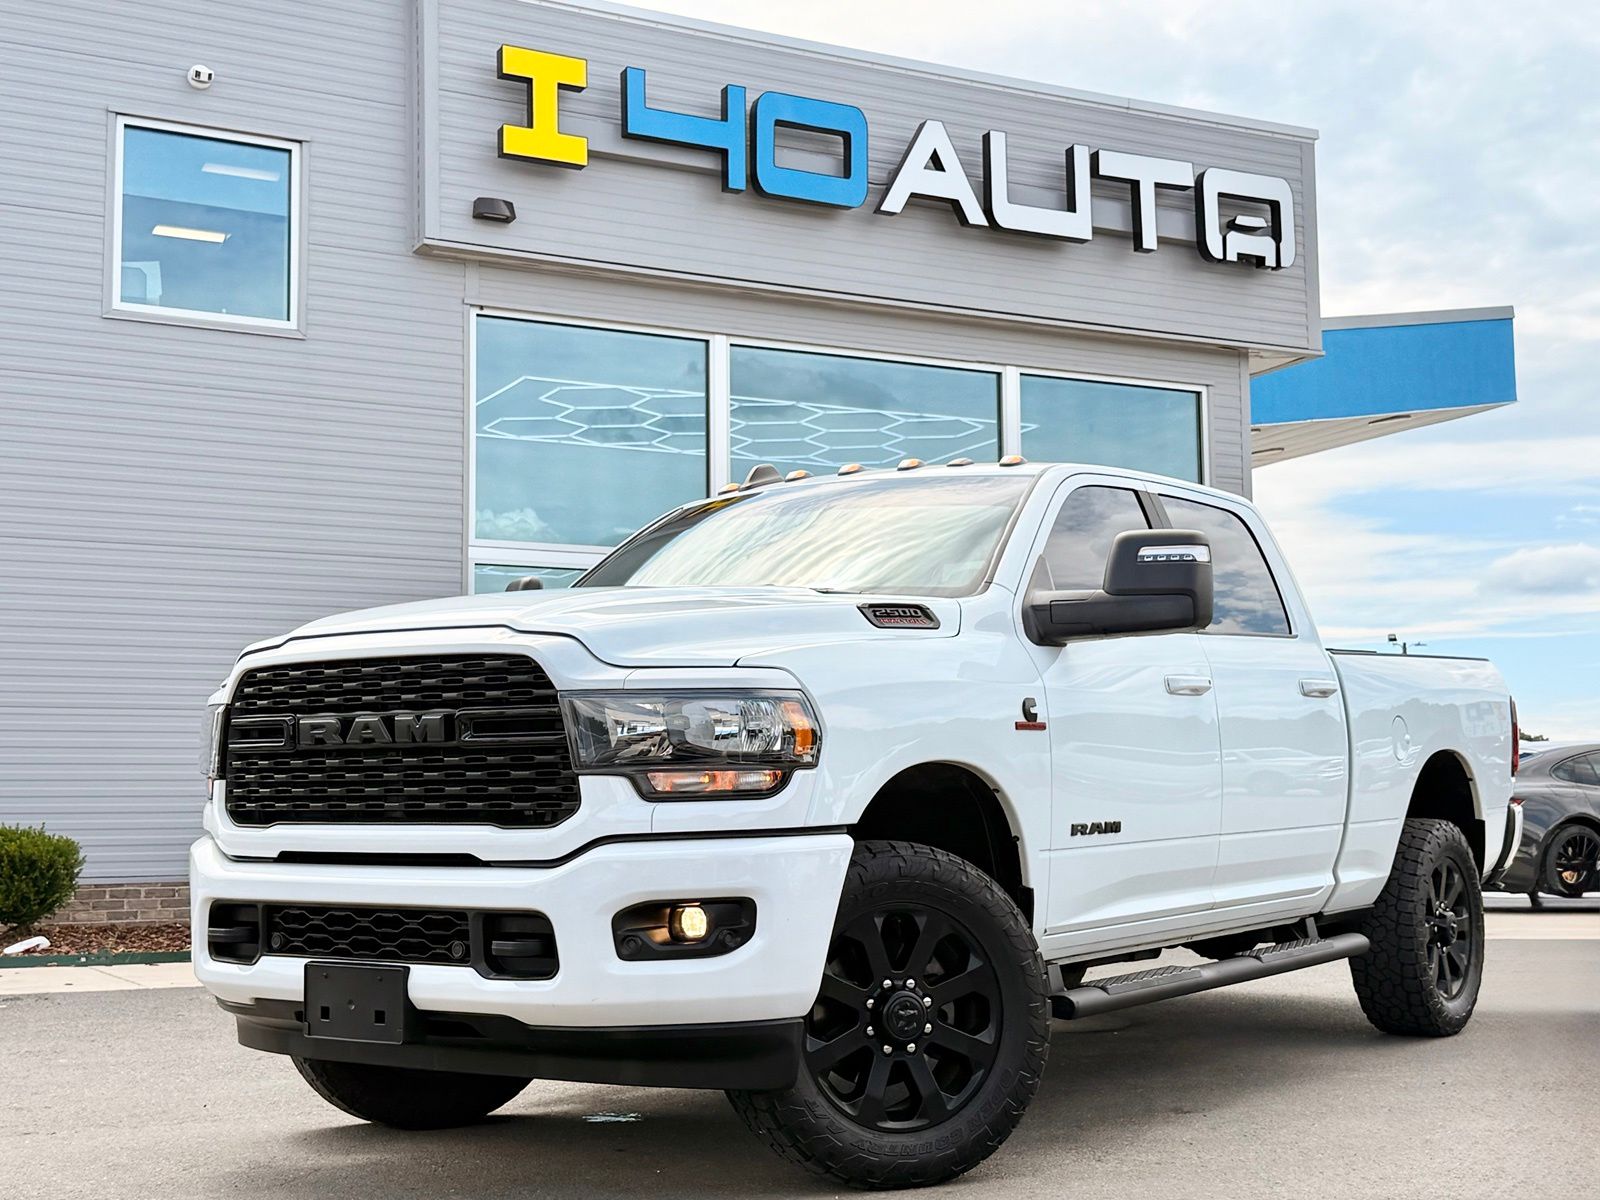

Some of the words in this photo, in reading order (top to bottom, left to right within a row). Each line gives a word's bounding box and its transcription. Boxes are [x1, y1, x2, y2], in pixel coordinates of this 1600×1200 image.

[872, 607, 922, 618] 2500
[298, 714, 446, 745] RAM
[1071, 820, 1122, 837] RAM
[849, 1128, 966, 1157] COUNTRY
